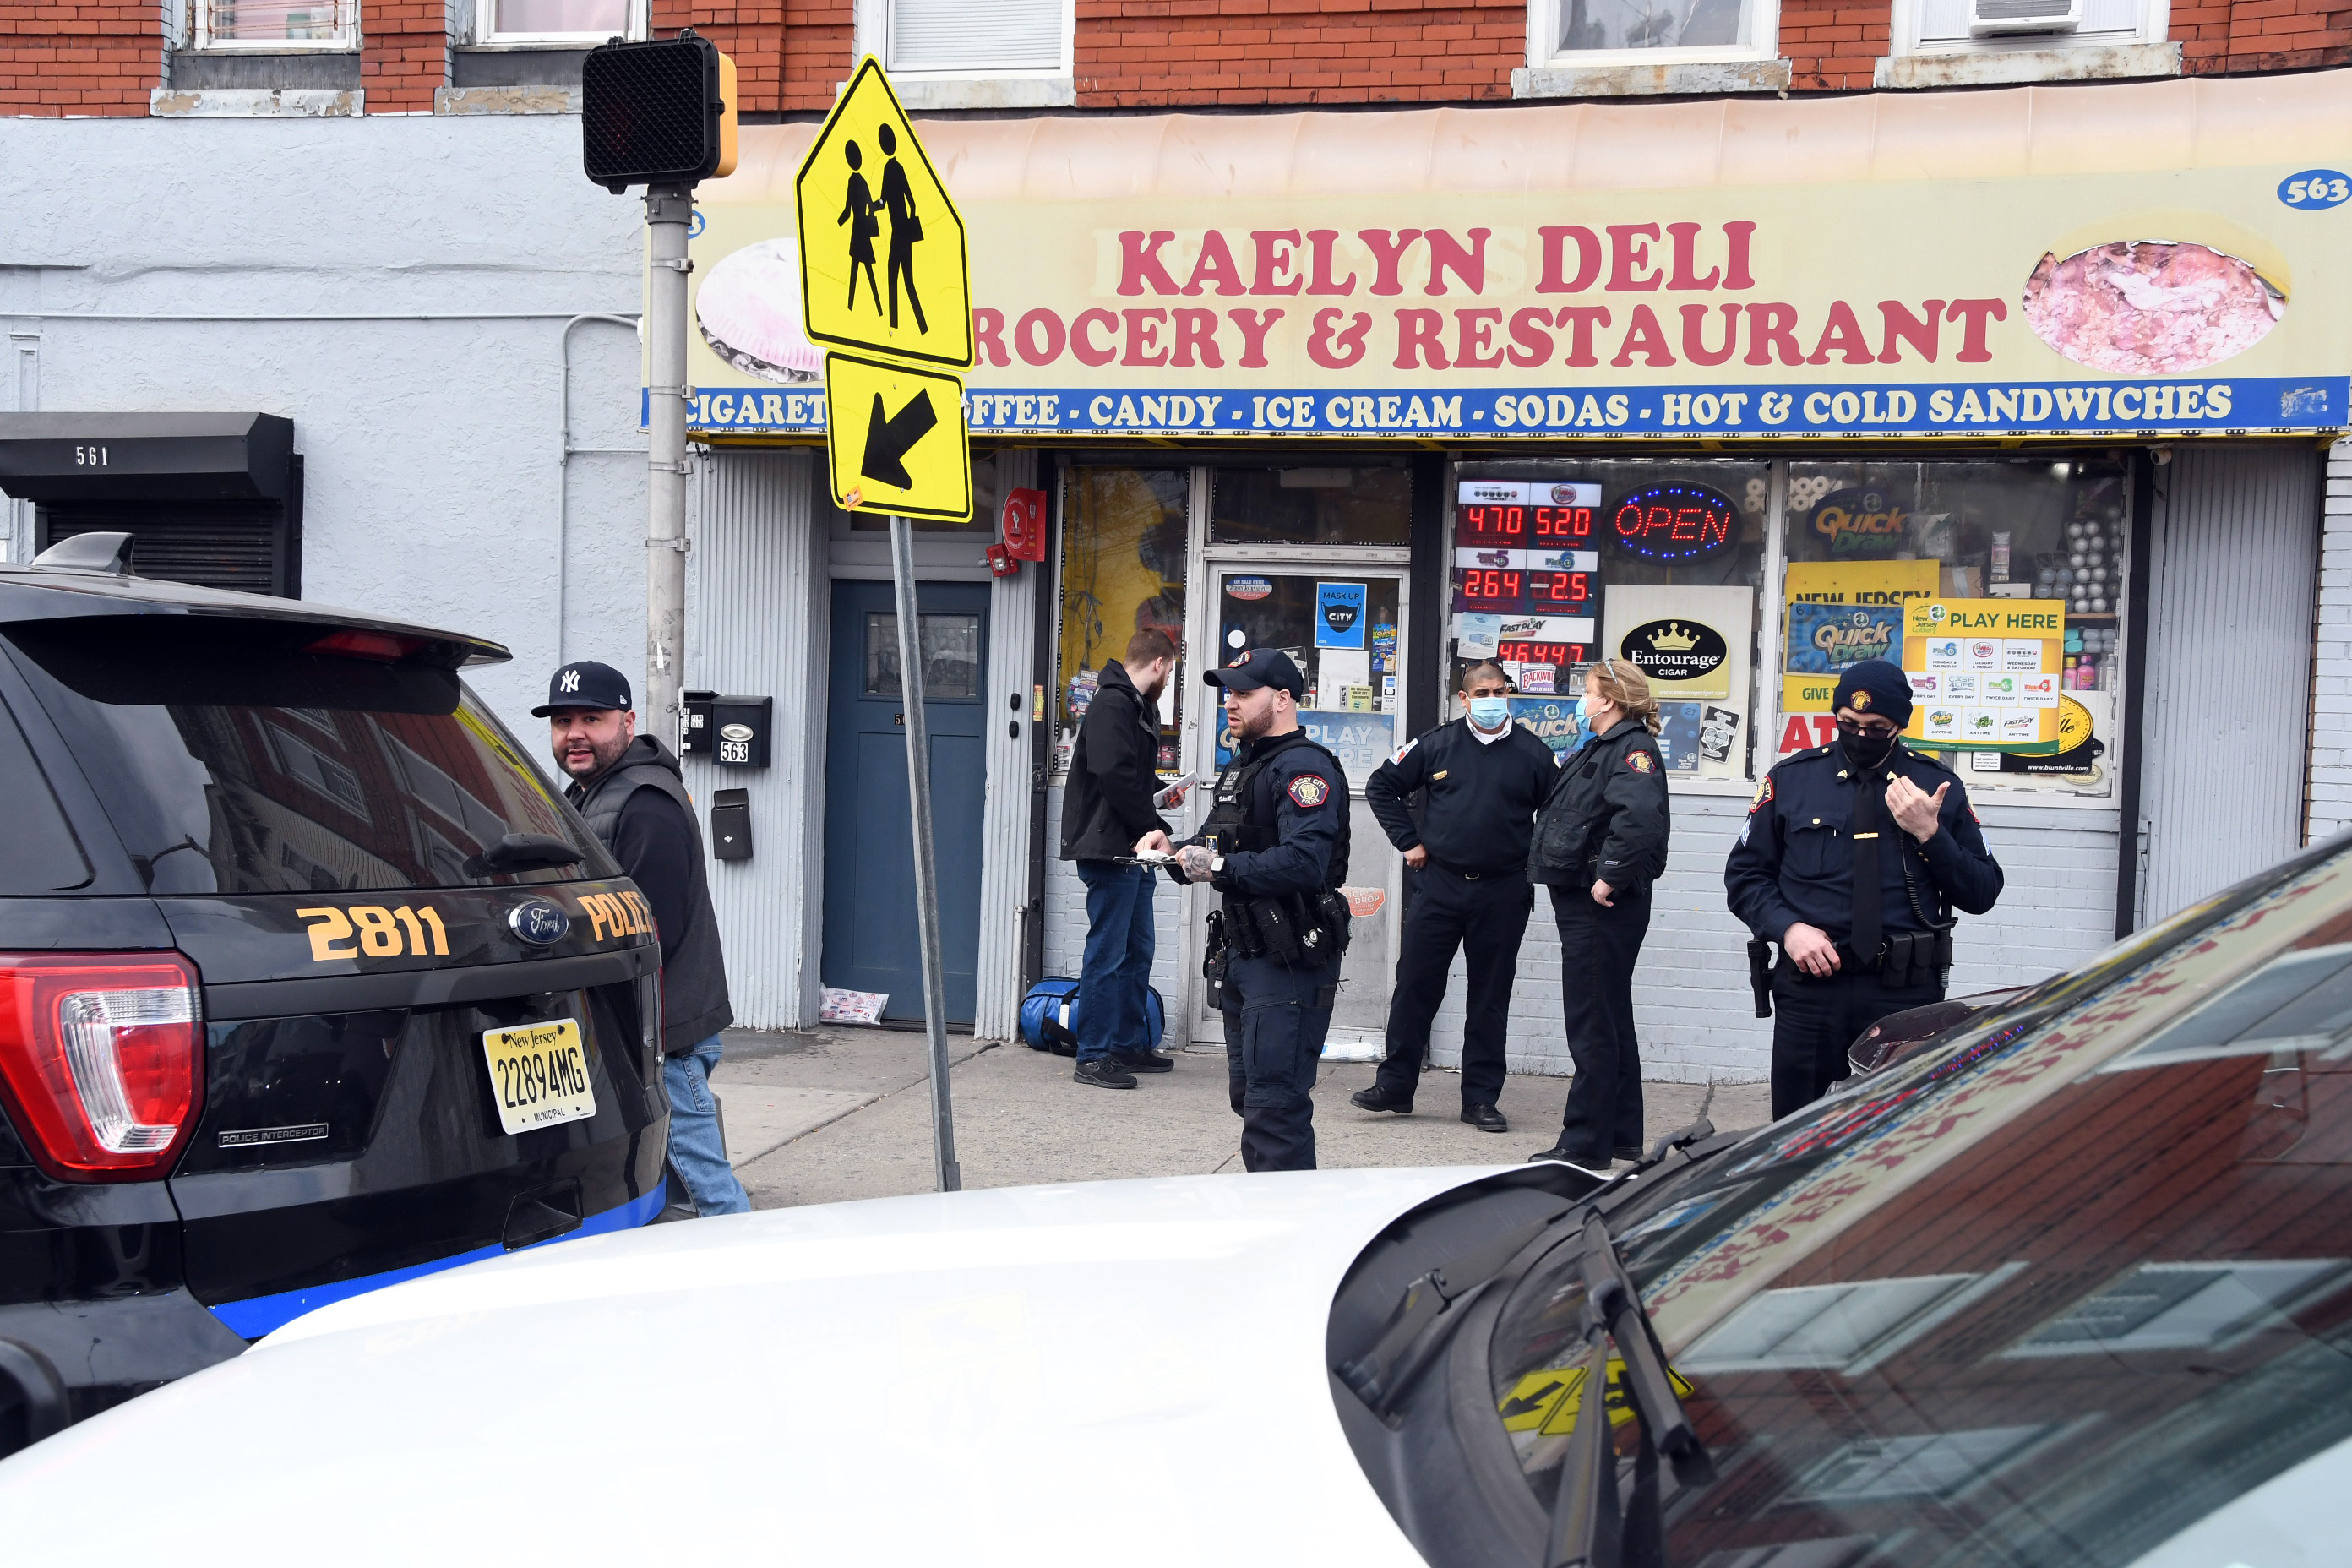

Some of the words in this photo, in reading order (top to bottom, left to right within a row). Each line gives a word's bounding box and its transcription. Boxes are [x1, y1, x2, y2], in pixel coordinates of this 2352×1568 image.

[2286, 177, 2349, 204] 563
[1116, 226, 1492, 297] KAELYN
[1535, 220, 1757, 294] DELI
[972, 306, 1285, 369] ROCERY
[1306, 306, 1373, 370] &
[1392, 297, 2008, 371] RESTAURANT
[686, 393, 827, 425] CIGARET
[969, 395, 1060, 426] FFEE
[1088, 395, 1223, 427] CANDY
[1252, 395, 1315, 428] ICE
[1325, 395, 1463, 428] CREAM
[1494, 394, 1629, 427] SODAS
[1661, 392, 1749, 426] HOT
[1758, 391, 1794, 425] &
[1803, 389, 1917, 424] COLD
[1928, 384, 2233, 422] SANDWICHES
[75, 446, 108, 466] 561
[1468, 506, 1522, 534] 470
[1536, 507, 1591, 536] 520
[1615, 504, 1730, 543] OPEN
[1464, 570, 1519, 597] 264
[1323, 591, 1347, 600] MASK
[1328, 612, 1353, 621] CITY
[1916, 620, 1938, 629] Jersey
[1950, 612, 2001, 628] PLAY
[2006, 613, 2058, 629] HERE
[1630, 650, 1720, 669] Entourage
[559, 669, 581, 693] NY
[1802, 687, 1830, 700] GIVE
[1305, 724, 1373, 745] PLAY
[1540, 735, 1578, 749] raw
[1778, 716, 1838, 754] AT
[721, 743, 747, 761] 563
[2027, 764, 2088, 772] www.bluntville.com
[1289, 777, 1311, 792] JERSEY
[1312, 778, 1327, 789] CITY
[1354, 895, 1380, 904] DROP
[529, 907, 561, 936] Ford
[576, 890, 653, 944] POLICE
[295, 904, 450, 962] 2811
[508, 1032, 530, 1049] New
[530, 1029, 557, 1049] Jersey
[497, 1046, 585, 1109] 22894MG
[533, 1107, 566, 1123] MUNICIPAL
[222, 1133, 259, 1144] POLICE
[261, 1126, 325, 1141] INTERCEPTOR
